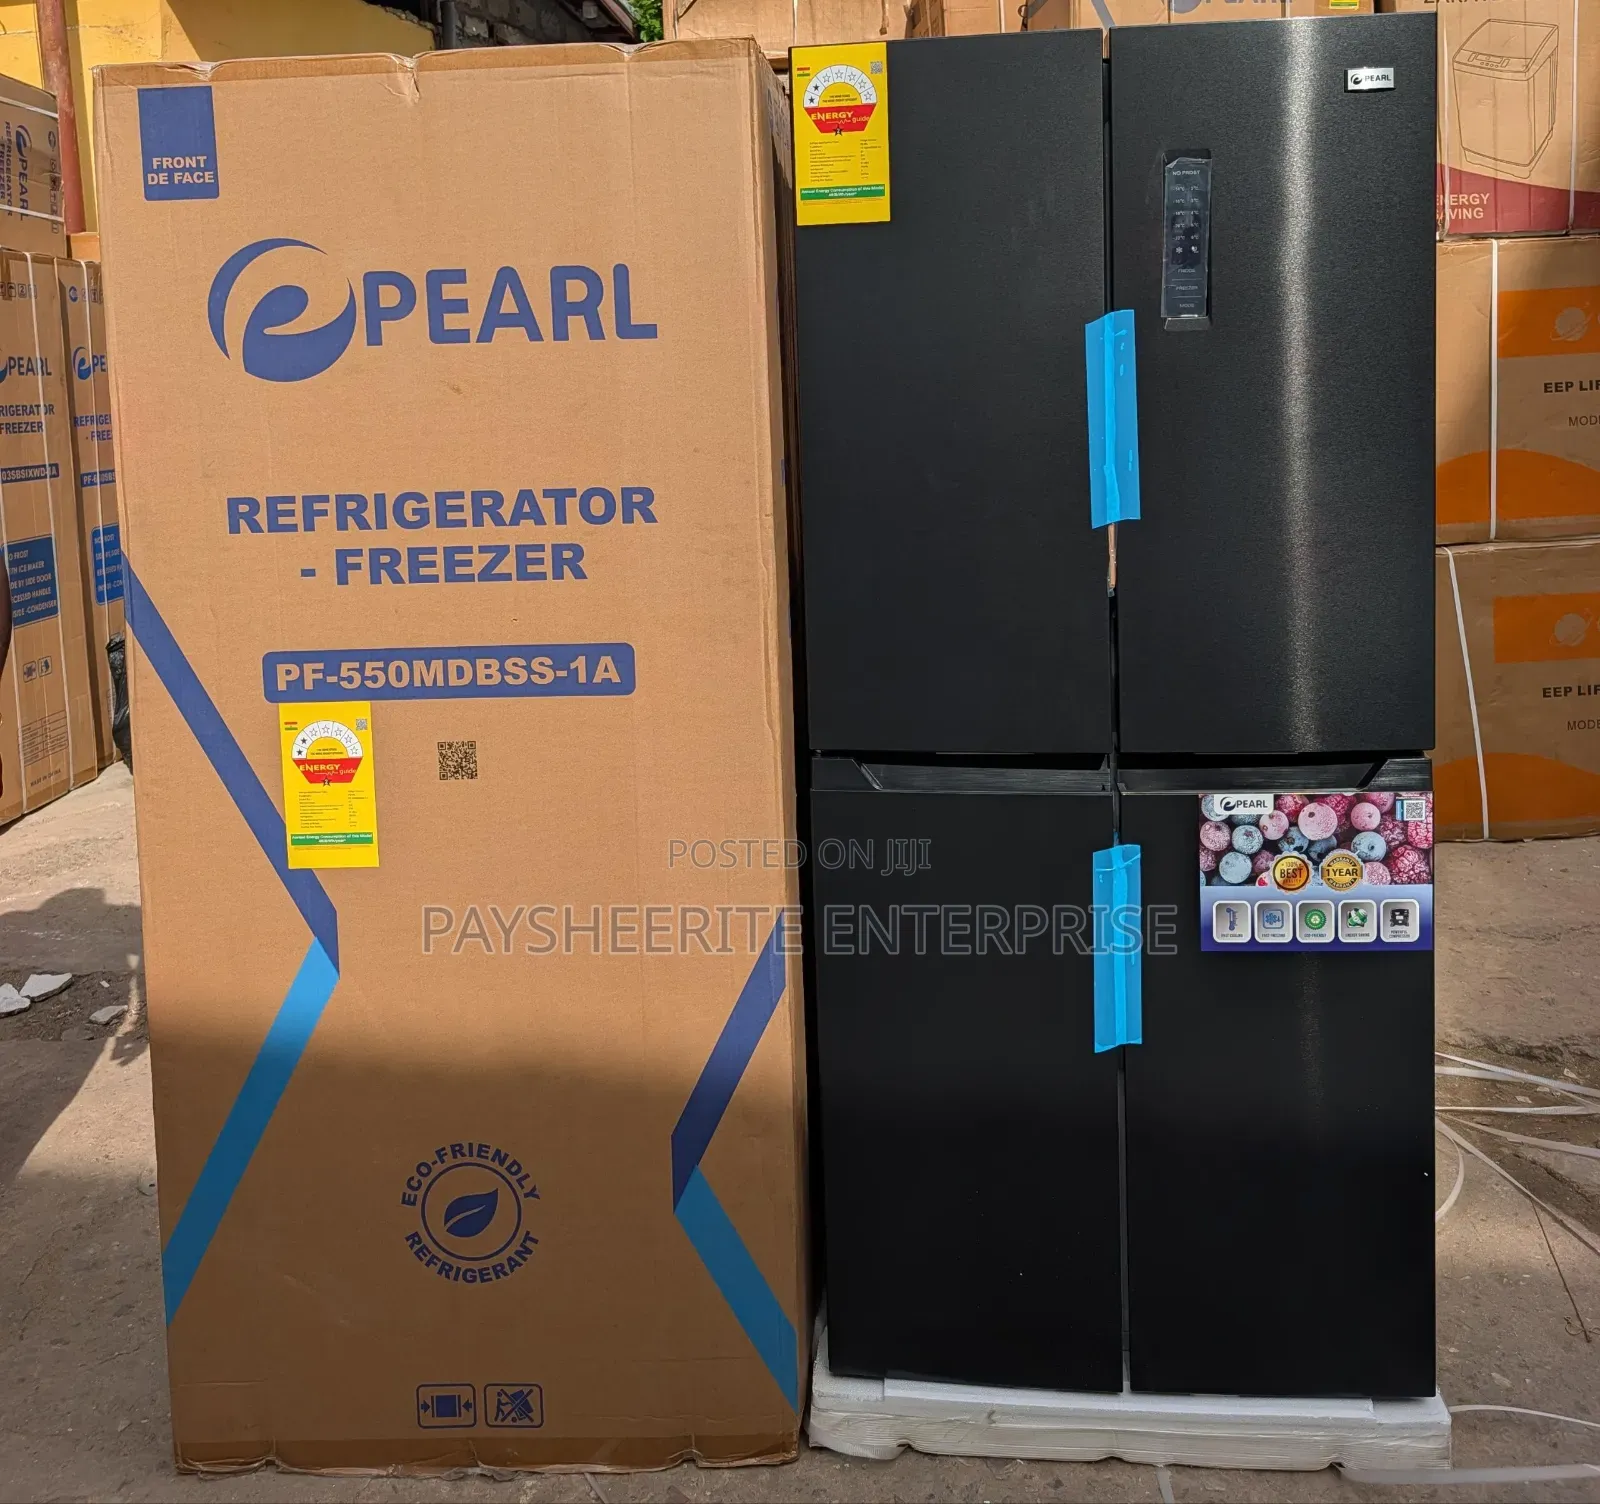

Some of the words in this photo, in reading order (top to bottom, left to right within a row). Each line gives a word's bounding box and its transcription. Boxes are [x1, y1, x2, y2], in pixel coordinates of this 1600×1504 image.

[811, 111, 854, 121] ENERGY
[152, 156, 207, 169] FRONT
[147, 173, 169, 185] DE
[174, 172, 214, 184] FACE
[18, 158, 28, 221] PEARL
[1437, 193, 1490, 206] ERGY
[1437, 207, 1484, 219] VING
[362, 263, 658, 346] PEARL
[8, 356, 52, 376] PEARL
[92, 355, 106, 373] PE
[1544, 381, 1574, 393] EEP
[1579, 379, 1600, 392] LIF
[0, 421, 44, 434] FREEZER
[1568, 415, 1600, 427] MOD
[91, 430, 112, 441] FREE
[226, 486, 659, 535] REFRIGERATOR
[301, 568, 316, 578] -
[335, 543, 588, 586] FREEZER
[276, 656, 621, 692] PF-550MDBSS-1A
[1542, 686, 1573, 698] EEP
[1577, 684, 1600, 696] LIF
[299, 764, 340, 772] ENERGY
[1237, 800, 1268, 808] PEARL
[1280, 868, 1303, 879] BEST
[1326, 869, 1330, 877] 1
[1332, 869, 1358, 877] YEAR
[401, 1142, 540, 1207] ECO-FRIENDLY
[404, 1230, 540, 1284] REFRIGERANT
